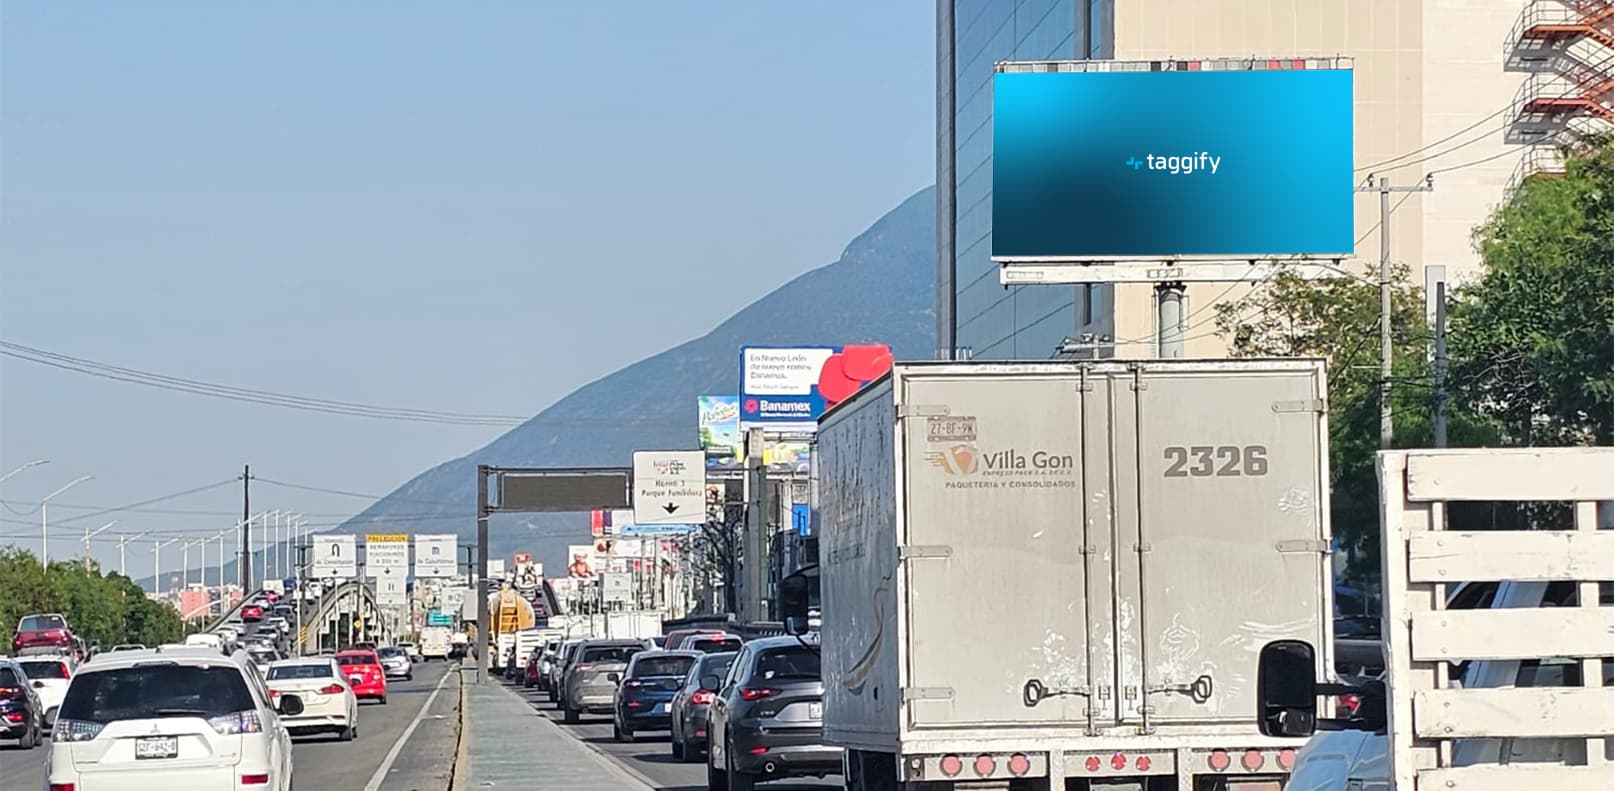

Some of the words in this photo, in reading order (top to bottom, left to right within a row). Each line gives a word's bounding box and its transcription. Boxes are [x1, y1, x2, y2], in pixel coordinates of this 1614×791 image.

[1146, 151, 1221, 174] taggify
[760, 400, 811, 411] Banamex
[983, 448, 1026, 469] Villa
[1032, 451, 1073, 468] Gon
[1163, 445, 1268, 477] 2326
[1008, 480, 1076, 488] CONSOLIDADOS
[641, 489, 666, 498] Parque
